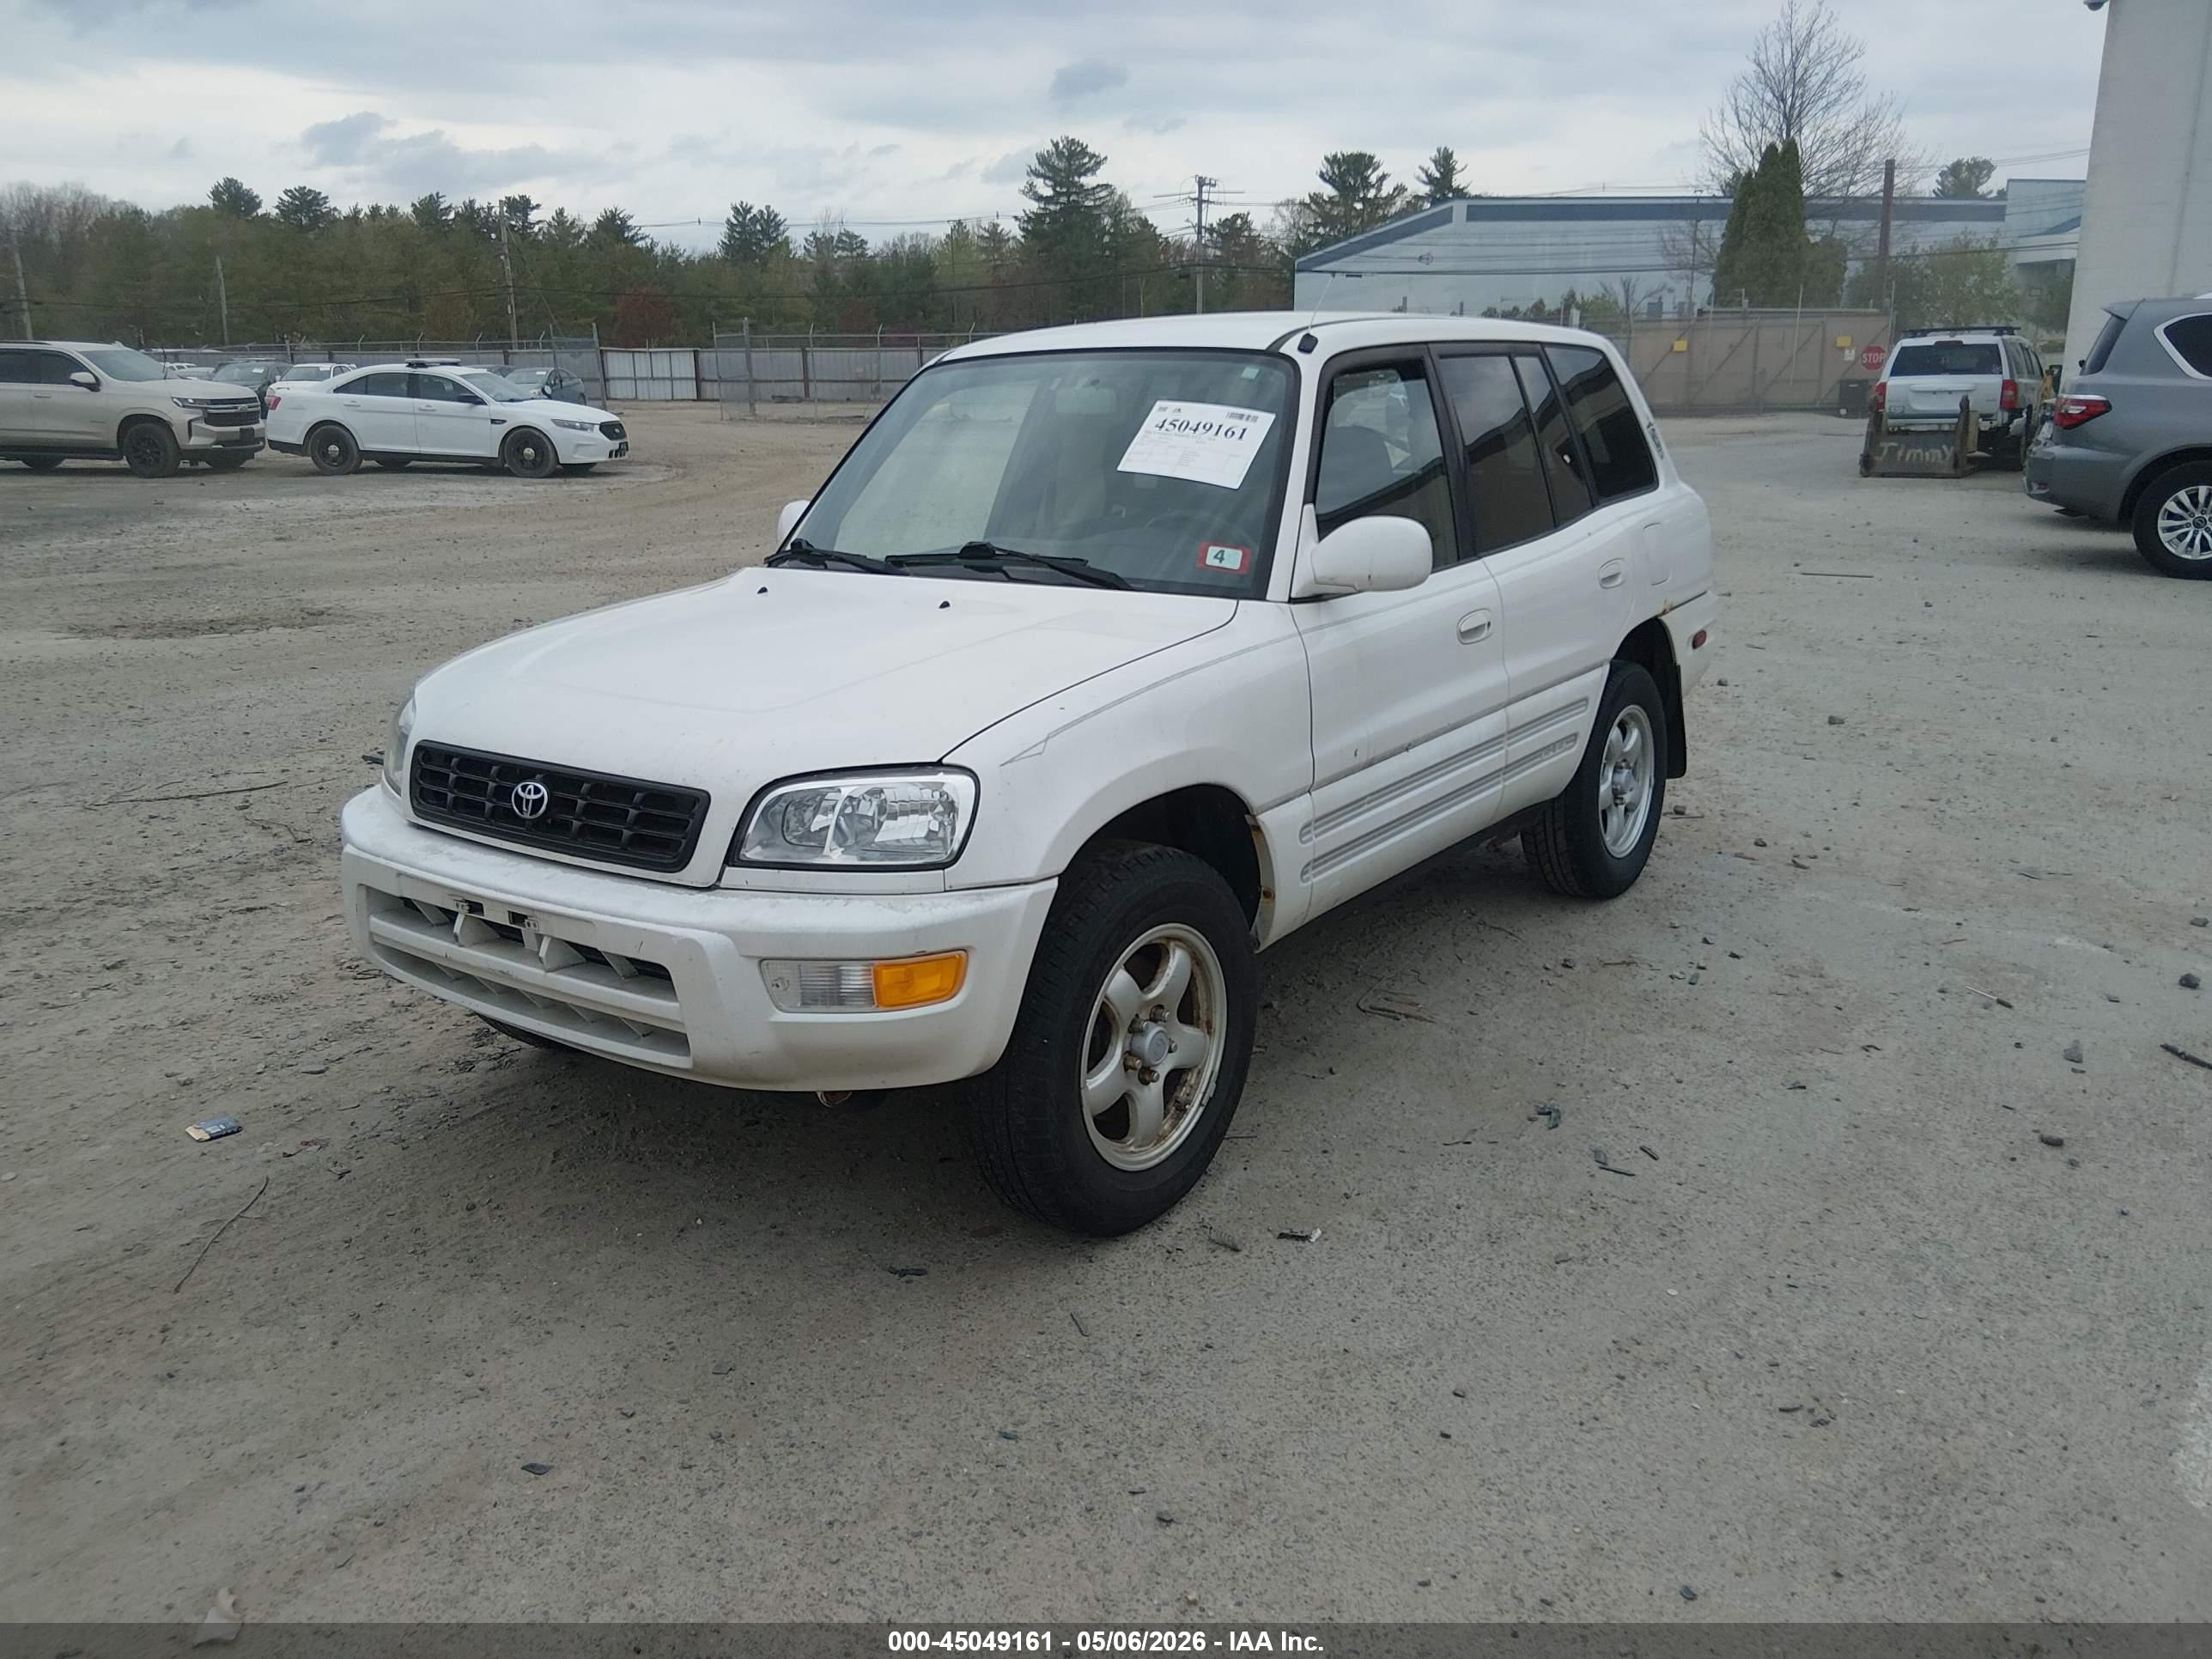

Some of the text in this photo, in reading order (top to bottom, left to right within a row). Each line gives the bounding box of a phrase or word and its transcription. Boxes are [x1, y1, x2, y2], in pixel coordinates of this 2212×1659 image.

[1862, 352, 1886, 364] STOP
[1155, 418, 1249, 441] 45049161
[1213, 550, 1225, 563] 4
